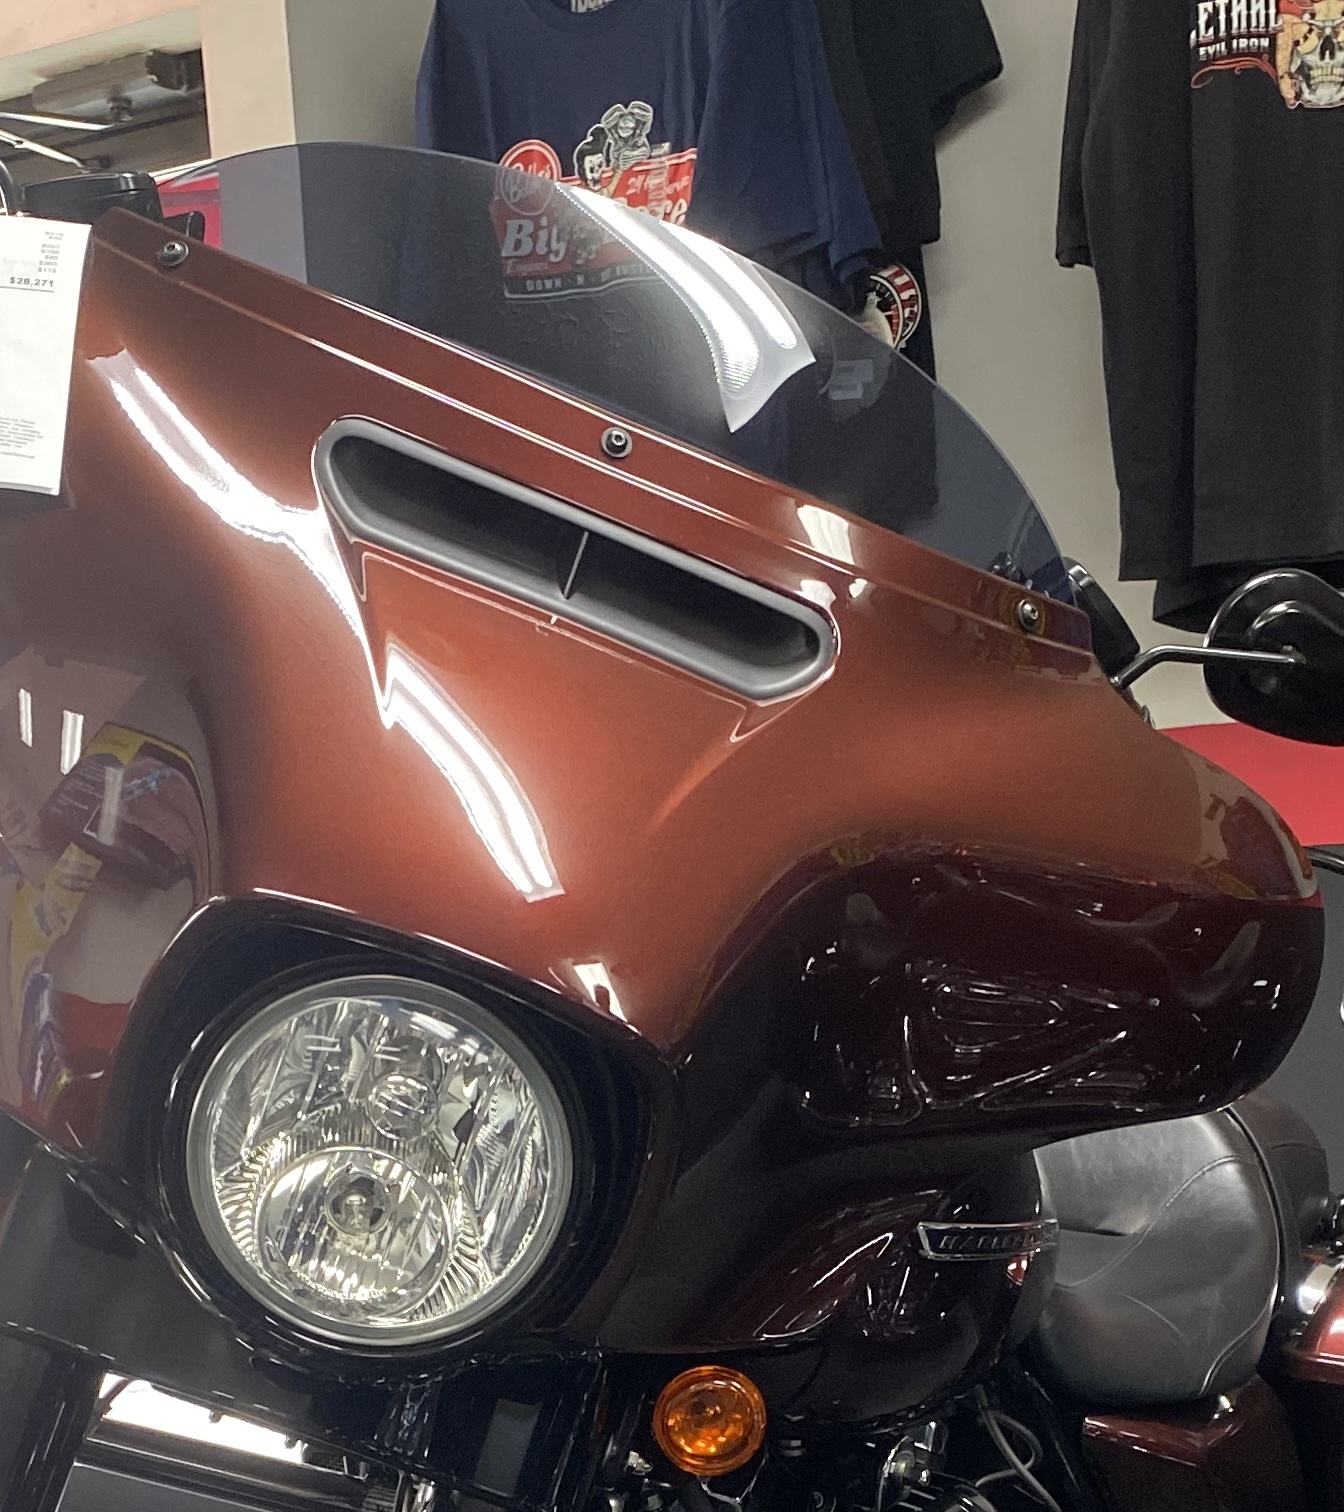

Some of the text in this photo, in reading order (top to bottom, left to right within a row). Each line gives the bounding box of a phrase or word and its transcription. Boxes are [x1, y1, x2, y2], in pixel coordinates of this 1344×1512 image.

[1189, 0, 1285, 50] ETHAL
[1198, 37, 1270, 61] EVIL IRON
[500, 215, 568, 263] Big
[9, 276, 54, 288] $28,271
